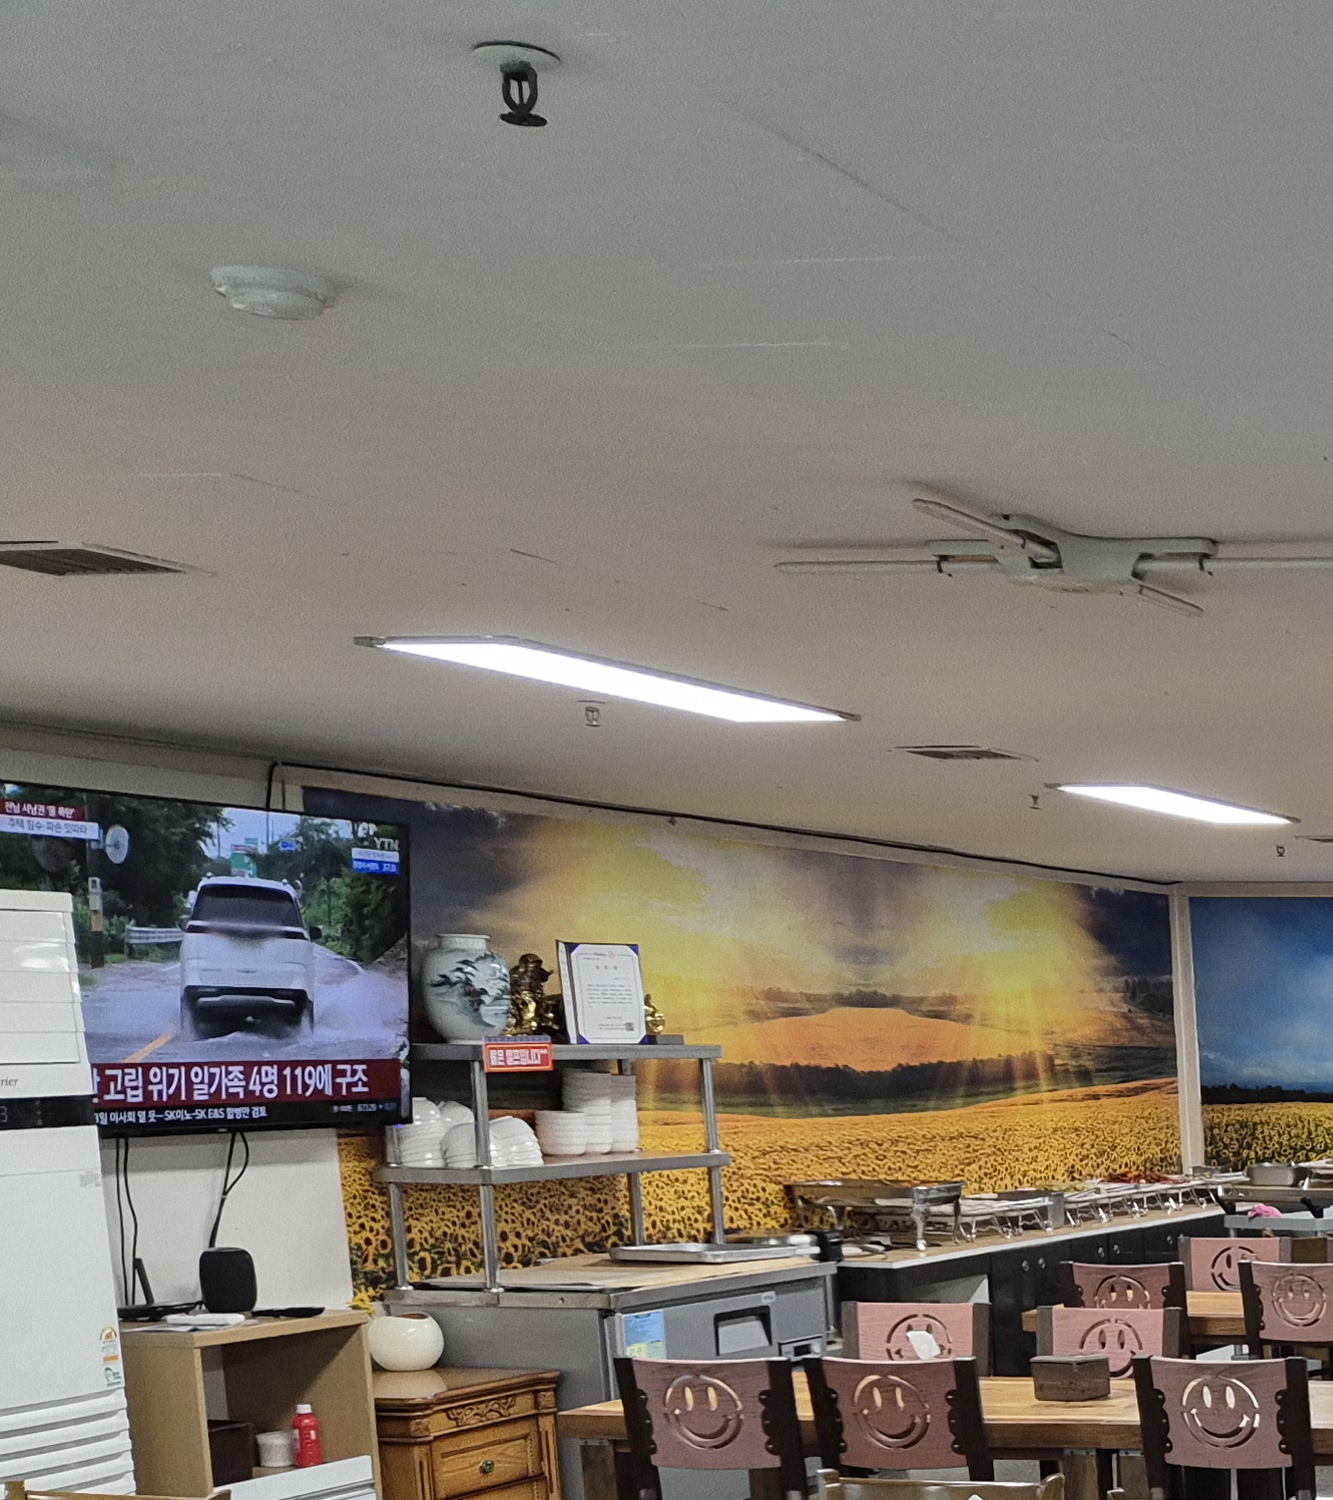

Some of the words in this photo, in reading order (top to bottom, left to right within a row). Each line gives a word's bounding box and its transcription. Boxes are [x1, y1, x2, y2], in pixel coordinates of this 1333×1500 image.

[373, 837, 399, 851] YTN
[103, 1066, 144, 1103] 고립
[147, 1066, 187, 1101] 위기
[189, 1064, 247, 1100] 일가족
[248, 1065, 279, 1099] 4명
[281, 1064, 333, 1098] 119에
[335, 1063, 370, 1096] 구조
[109, 1111, 136, 1124] 이사회
[207, 1107, 225, 1119] E&S
